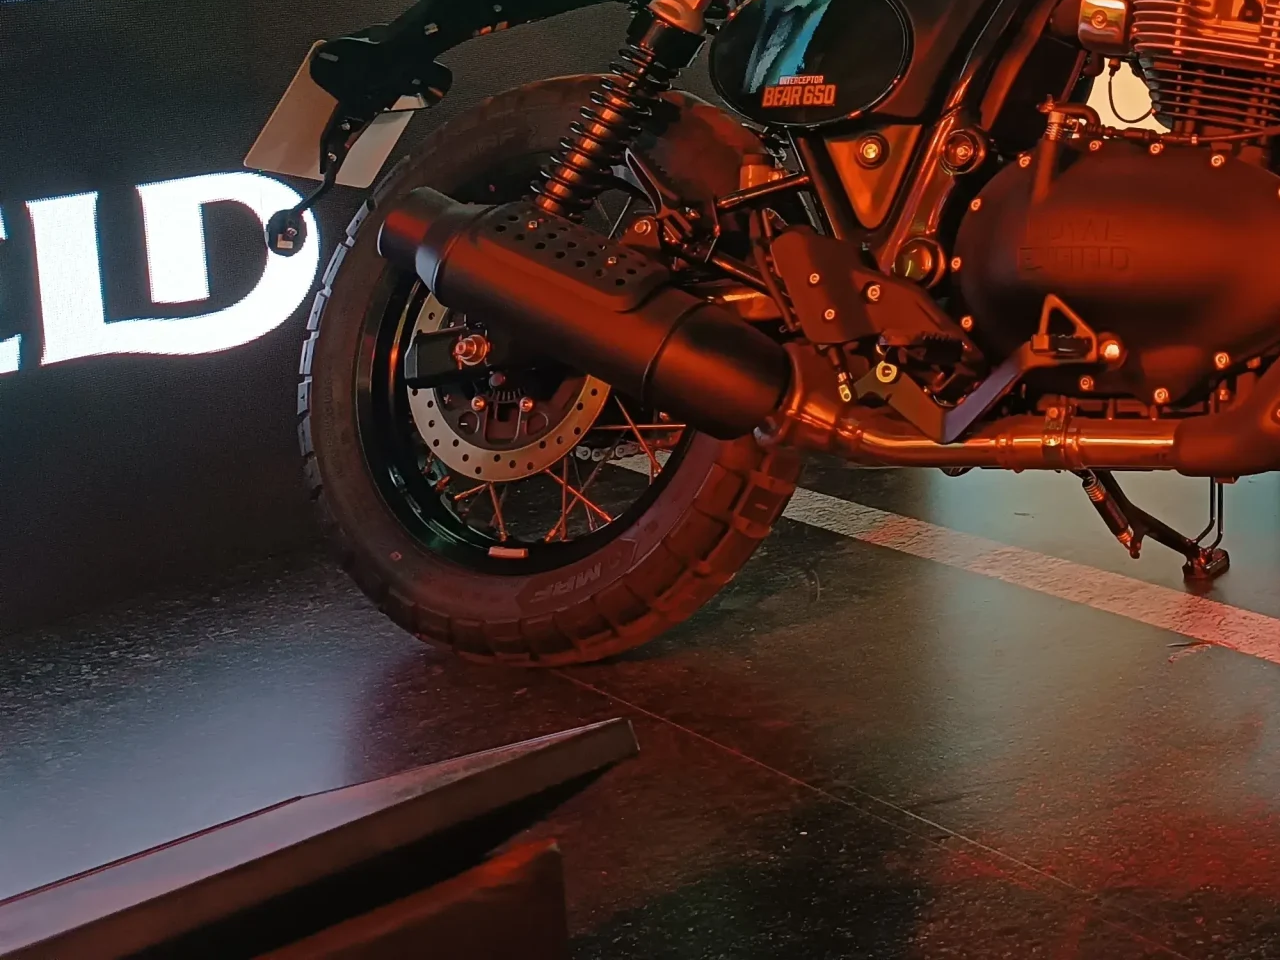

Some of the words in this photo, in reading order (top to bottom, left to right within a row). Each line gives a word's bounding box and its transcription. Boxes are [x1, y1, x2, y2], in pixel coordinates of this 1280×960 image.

[779, 75, 824, 85] INTERCEPTOR
[762, 86, 803, 109] BEAR
[803, 84, 837, 106] 650
[0, 171, 320, 375] LD
